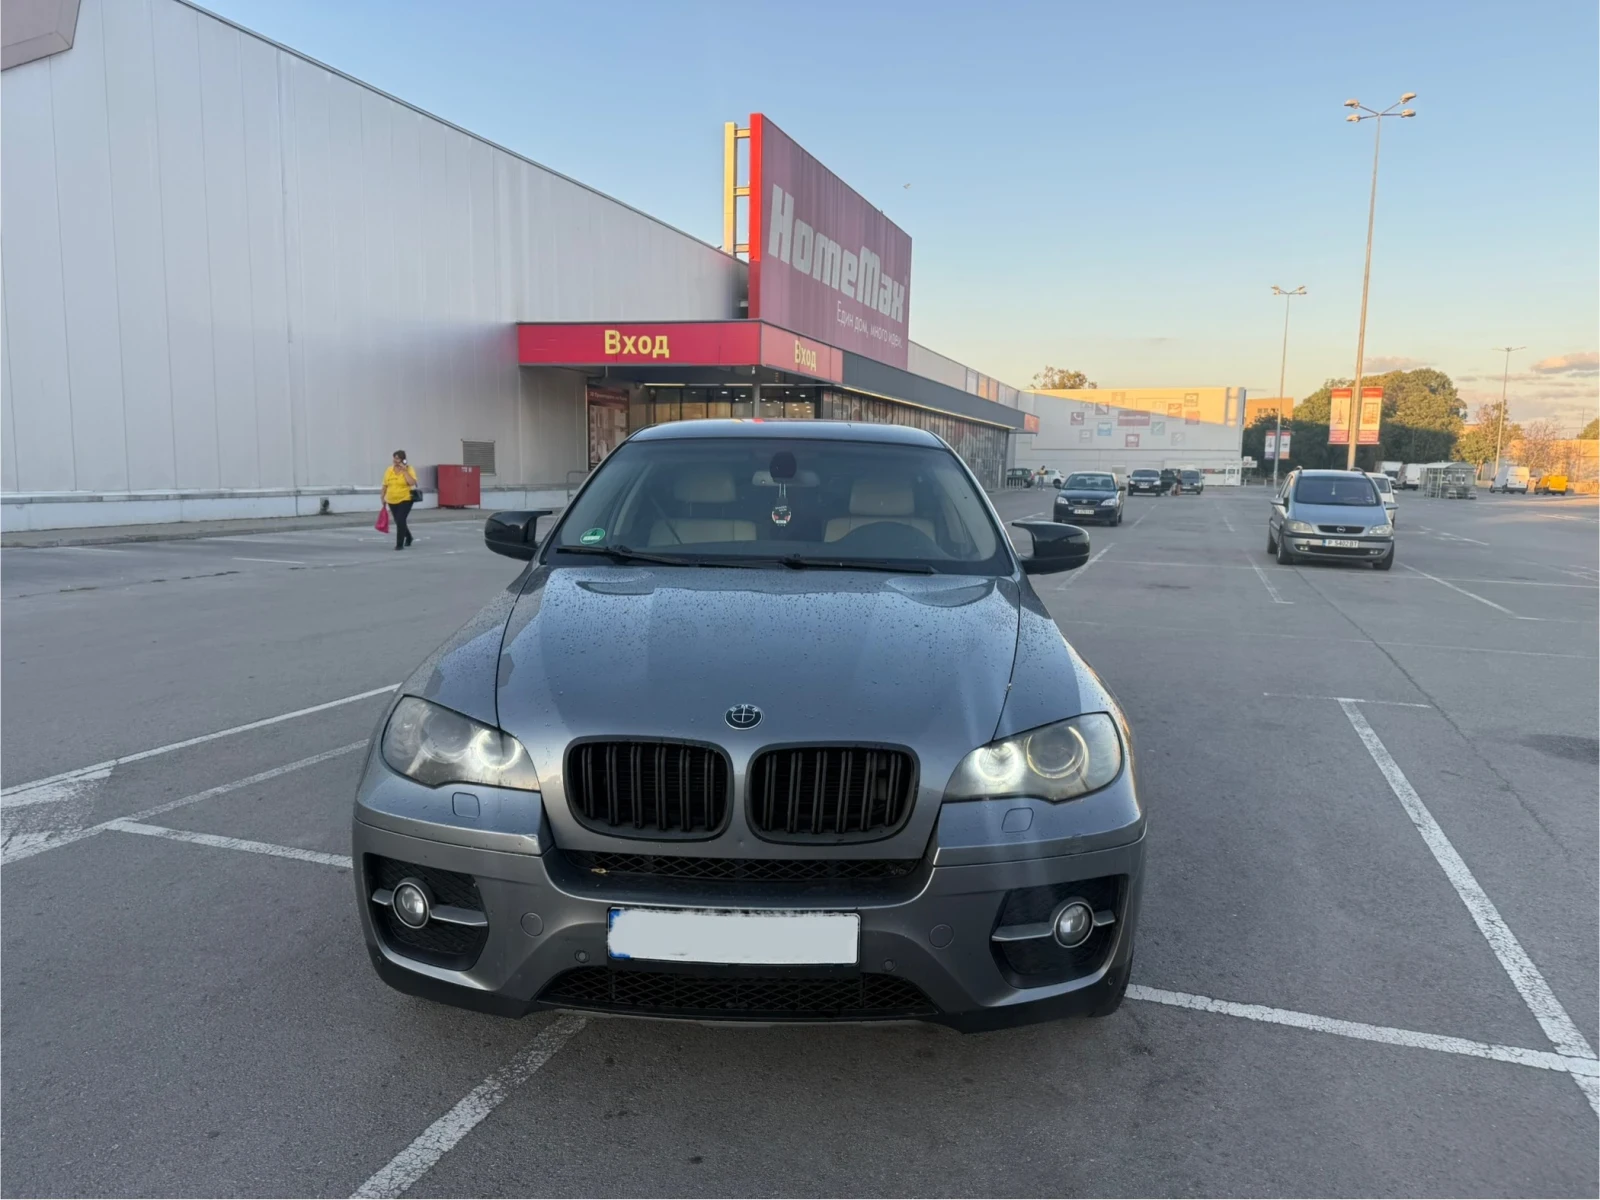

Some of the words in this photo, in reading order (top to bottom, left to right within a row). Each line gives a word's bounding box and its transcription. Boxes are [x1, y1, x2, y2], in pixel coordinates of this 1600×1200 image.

[768, 184, 905, 323] HomeMax
[837, 300, 853, 327] Един
[604, 330, 669, 358] Вход
[794, 340, 817, 371] Вход
